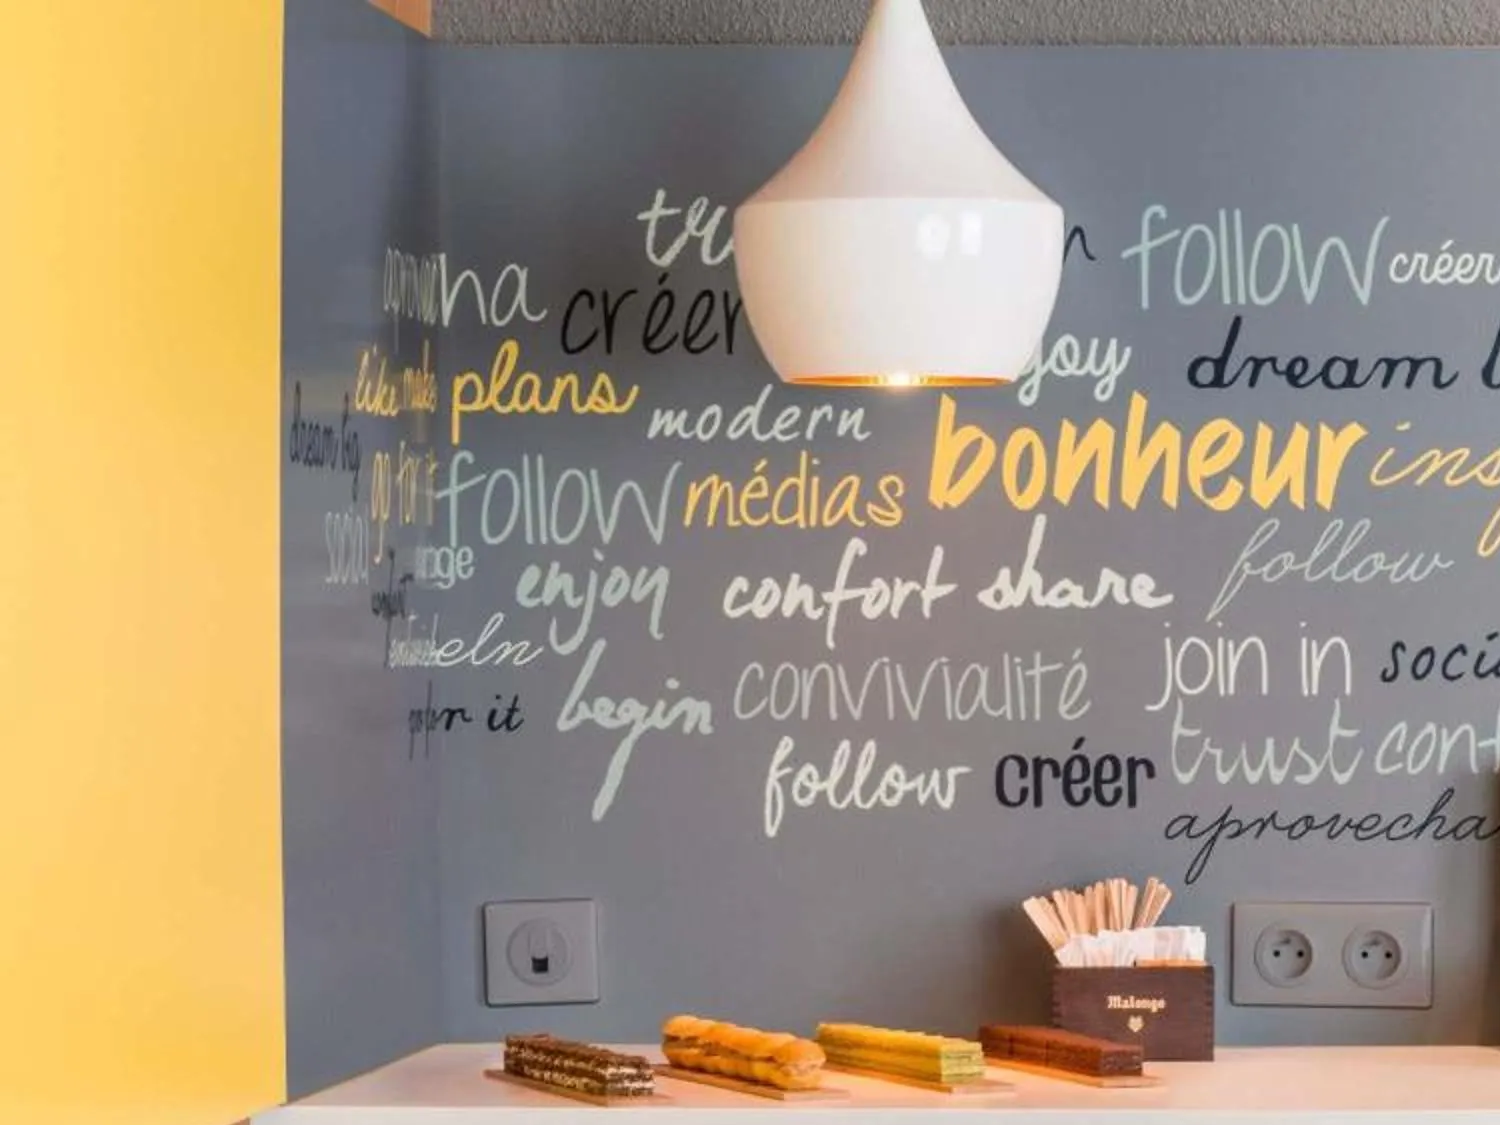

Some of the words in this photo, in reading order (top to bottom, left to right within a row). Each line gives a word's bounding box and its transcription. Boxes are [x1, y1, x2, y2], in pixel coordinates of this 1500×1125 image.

[1120, 205, 1390, 309] follow
[560, 271, 742, 356] créer
[1187, 315, 1459, 391] dream
[451, 339, 640, 446] plans
[647, 384, 871, 443] modern
[683, 450, 905, 528] médias
[927, 391, 1370, 511] bonheur
[435, 449, 684, 552] follow
[516, 548, 670, 655] enjoy
[723, 536, 957, 649] confort
[976, 513, 1175, 611] share
[1205, 516, 1456, 623] follow
[486, 693, 526, 732] it
[734, 648, 1093, 722] convivialité
[1145, 621, 1270, 711] join
[1300, 621, 1355, 697] in
[556, 638, 714, 822] begin
[994, 737, 1157, 809] créer
[1169, 698, 1367, 786] trust
[762, 735, 972, 838] follow
